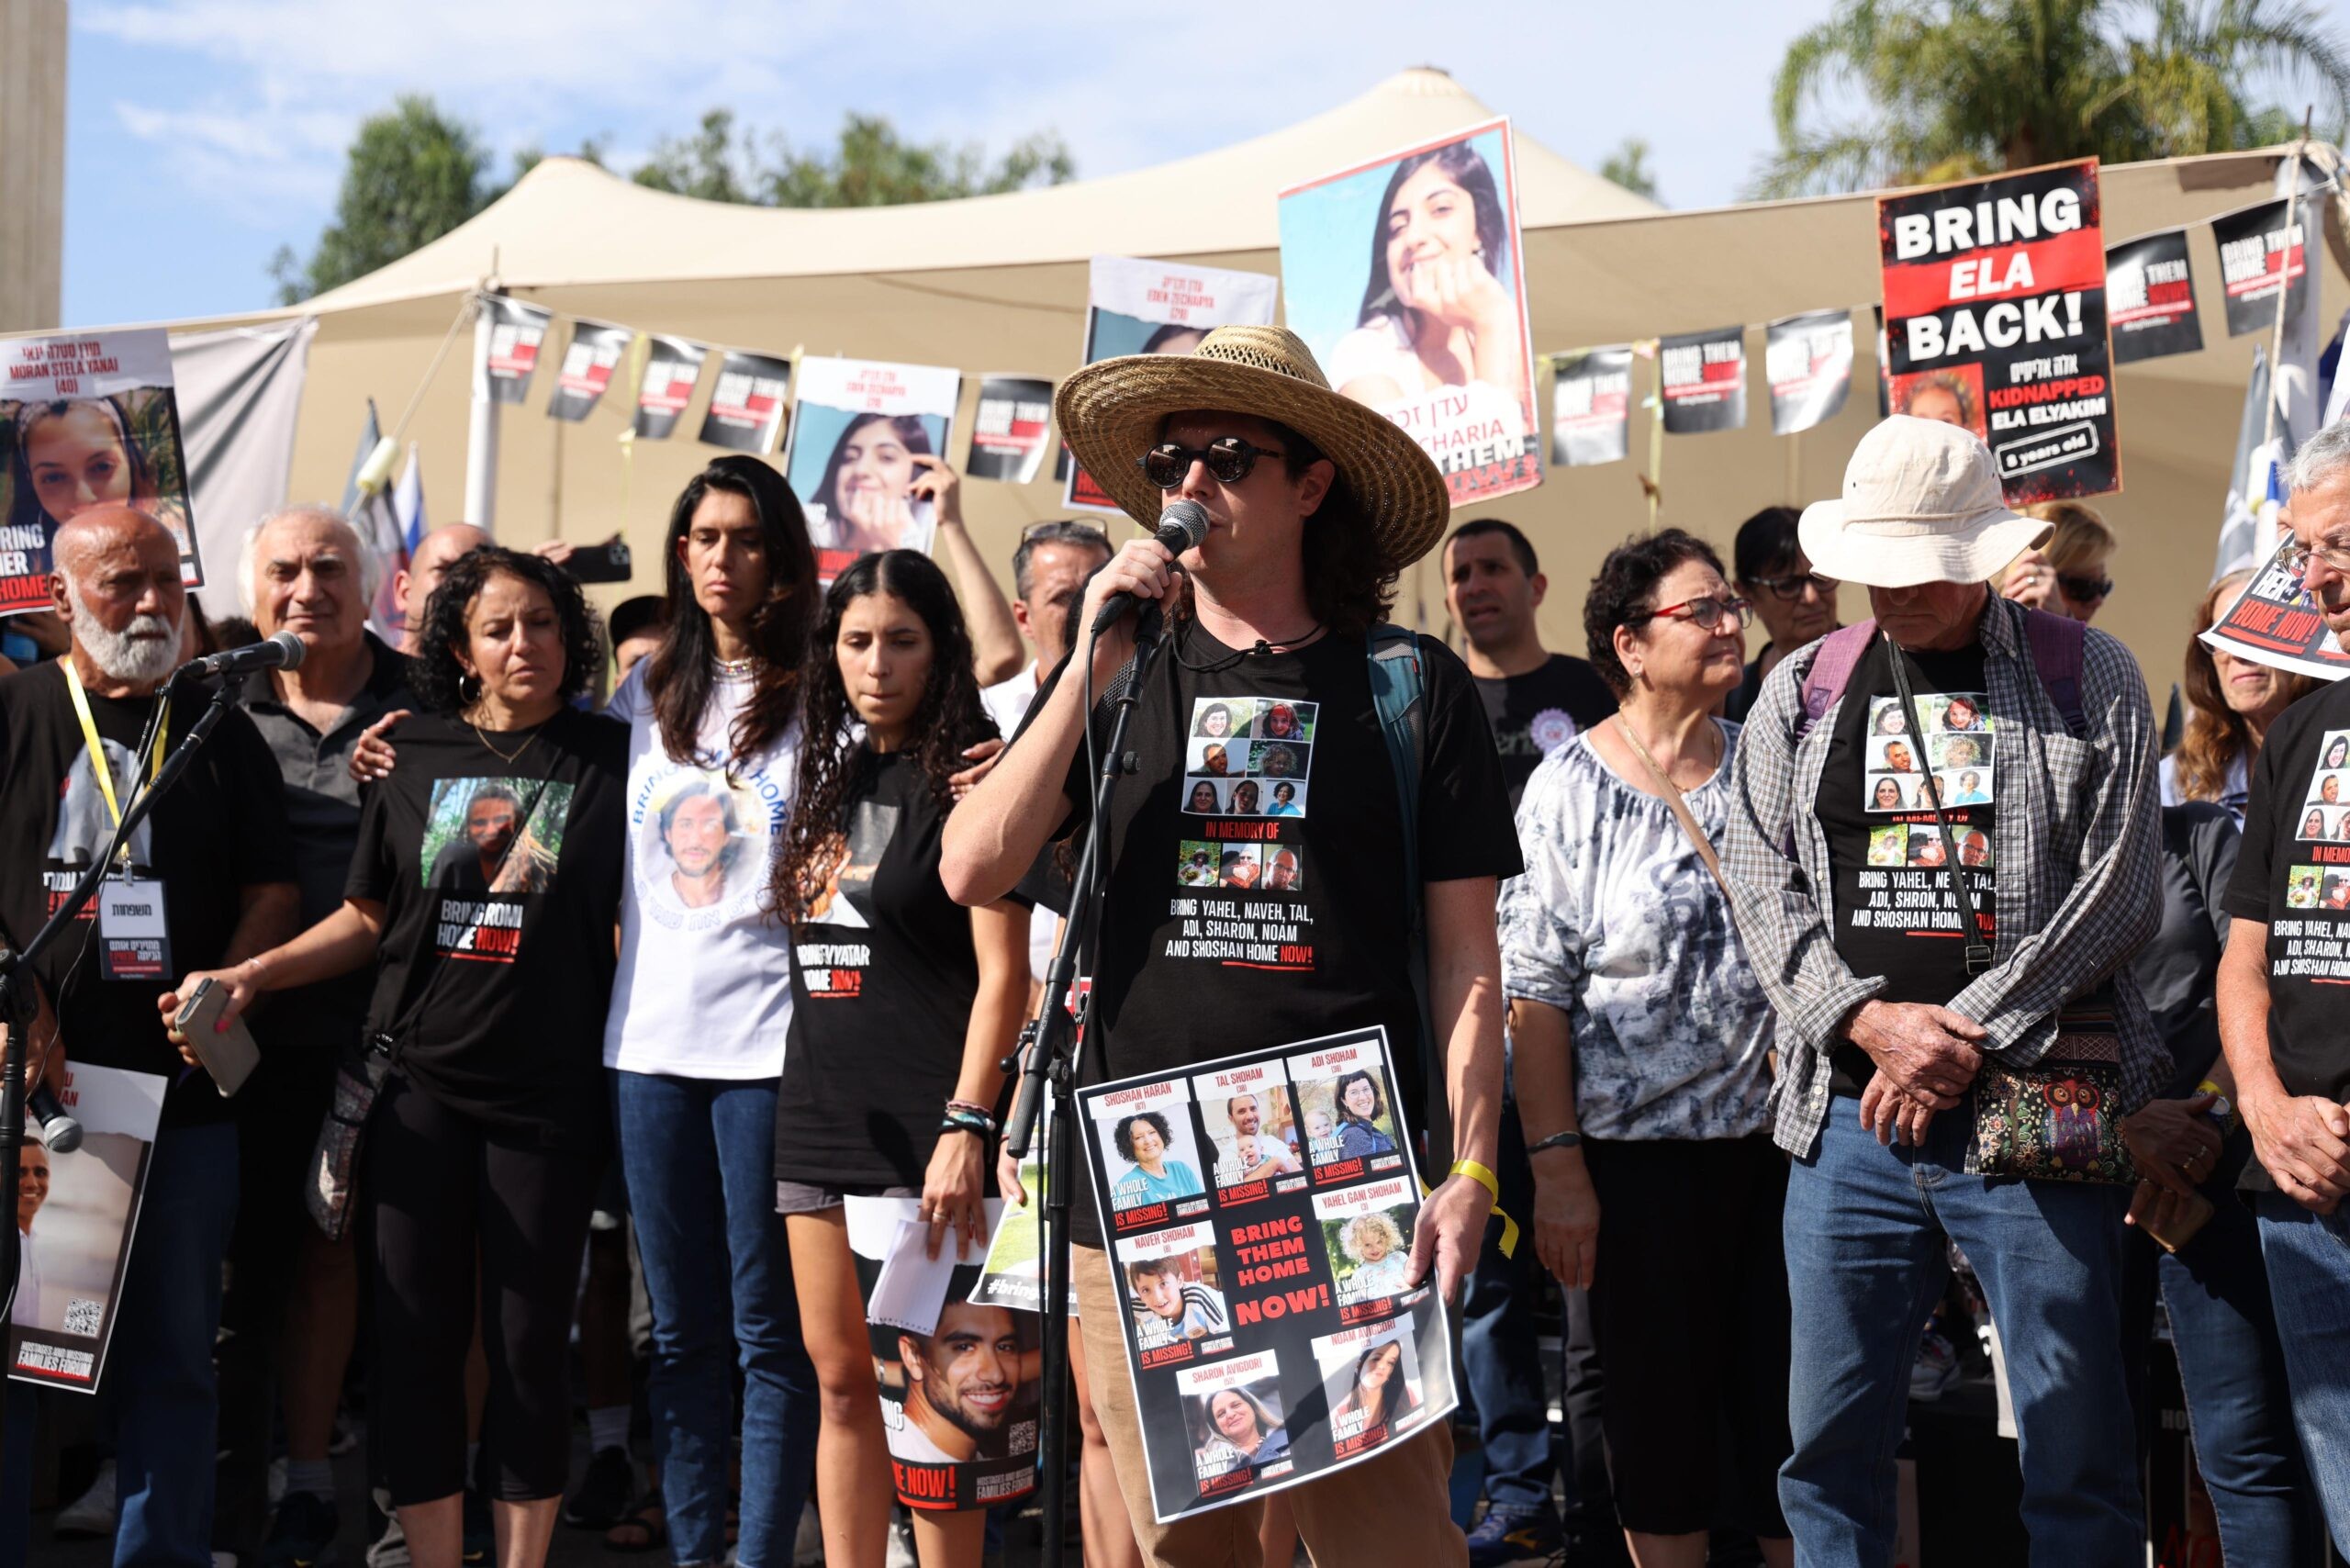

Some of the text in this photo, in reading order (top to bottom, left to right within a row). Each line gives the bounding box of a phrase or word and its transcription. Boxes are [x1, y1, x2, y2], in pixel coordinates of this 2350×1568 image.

[1895, 187, 2081, 260] BRING
[1949, 252, 2034, 300] ELA
[1907, 292, 2083, 361] BACK!
[9, 356, 119, 379] MORAN STELA YANAI
[55, 377, 79, 395] (40)
[1989, 375, 2106, 409] KIDNAPPED
[1431, 394, 1468, 428] עדן
[1991, 397, 2107, 431] ELA ELYAKIM
[2006, 433, 2087, 468] 8 years old
[1444, 454, 1539, 490] OW!
[0, 523, 45, 551] RING
[2229, 599, 2285, 633] HOME
[2273, 610, 2322, 644] NOW!
[749, 768, 787, 836] HOME
[1205, 822, 1280, 839] IN MEMORY OF
[2312, 846, 2350, 862] IN MEMO
[1859, 871, 1887, 888] BRING
[1892, 871, 1931, 891] YAHEL,
[112, 903, 151, 916] משפחות
[1170, 899, 1314, 924] BRING YAHEL, NAVEH, TAL,
[1868, 891, 1891, 910] ADI,
[1895, 891, 1940, 910] SHRON,
[441, 899, 524, 929] BRING ROMI
[1852, 910, 1871, 927] AND
[1873, 911, 1928, 929] SHOSHAN
[476, 926, 520, 955] NOW!
[1182, 920, 1297, 943] ADI, SHARON, NOAM
[2274, 920, 2333, 940] BRING YAHEL,
[1165, 940, 1313, 964] AND SHOSHAN HOME NOW!
[2287, 939, 2302, 958] ADI,
[2303, 940, 2344, 959] SHARON,
[2273, 959, 2350, 977] AND SHOSHAN HOM
[1311, 1047, 1358, 1069] ADI SHOHAM
[1215, 1067, 1264, 1088] TAL SHOHAM
[1104, 1081, 1172, 1107] SHOSHAN HARAN
[1308, 1135, 1345, 1154] A WHOLE
[1213, 1156, 1250, 1176] A WHOLE
[1310, 1148, 1339, 1167] FAMILY
[1314, 1167, 1323, 1181] IS
[1325, 1156, 1363, 1179] MISSING!
[1110, 1177, 1148, 1198] A WHOLE
[1214, 1170, 1244, 1189] FAMILY
[1217, 1189, 1227, 1203] IS
[1229, 1179, 1269, 1201] MISSING!
[1112, 1193, 1144, 1212] FAMILY
[1322, 1182, 1403, 1209] YAHEL GANI SHOHAM
[1114, 1213, 1125, 1226] IS
[1125, 1201, 1169, 1224] MISSING!
[1134, 1226, 1195, 1249] NAVEH SHOHAM
[1230, 1215, 1304, 1246] BRING
[1237, 1236, 1305, 1265] THEM
[1237, 1257, 1311, 1286] HOME
[1235, 1283, 1330, 1326] NOW!
[1340, 1307, 1350, 1320] IS
[1351, 1296, 1393, 1318] MISSING!
[1136, 1317, 1174, 1338] A WHOLE
[1331, 1318, 1396, 1346] NOAM AVIGDORI
[1137, 1333, 1169, 1351] FAMILY
[1141, 1351, 1150, 1365] IS
[1152, 1340, 1193, 1362] MISSING!
[1192, 1358, 1263, 1383] SHARON AVIGDORI
[1331, 1406, 1371, 1430] A WHOLE
[1332, 1420, 1364, 1441] FAMILY
[1335, 1424, 1388, 1455] IS MISSING!
[1196, 1447, 1236, 1467] A WHOLE
[906, 1465, 956, 1498] NOW!
[1197, 1461, 1229, 1480] FAMILY
[1200, 1479, 1210, 1493] IS
[1212, 1466, 1253, 1490] MISSING!
